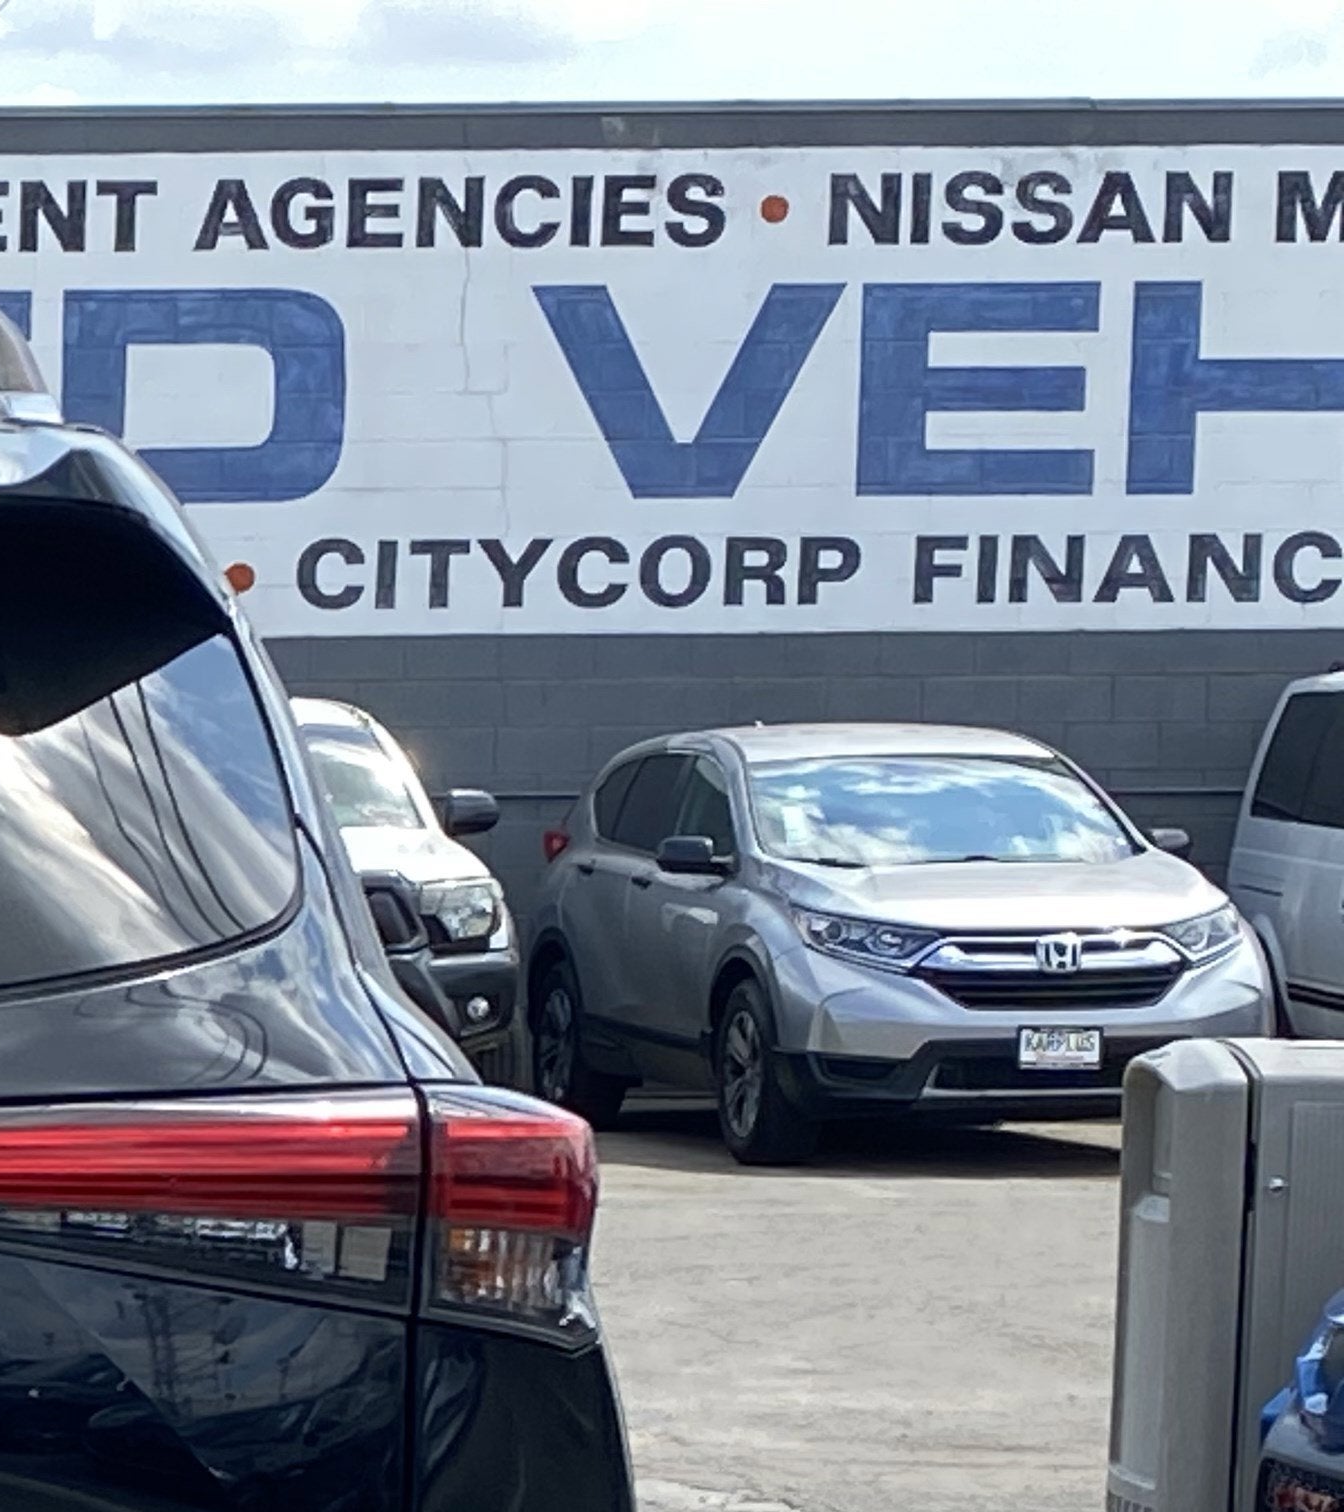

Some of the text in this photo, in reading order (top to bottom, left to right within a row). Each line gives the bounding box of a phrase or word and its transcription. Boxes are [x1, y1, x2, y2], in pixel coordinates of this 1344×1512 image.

[194, 174, 726, 251] AGENCIES
[828, 171, 1233, 245] NISSAN
[297, 535, 862, 609] CITYCORP
[913, 531, 1343, 605] FINANC
